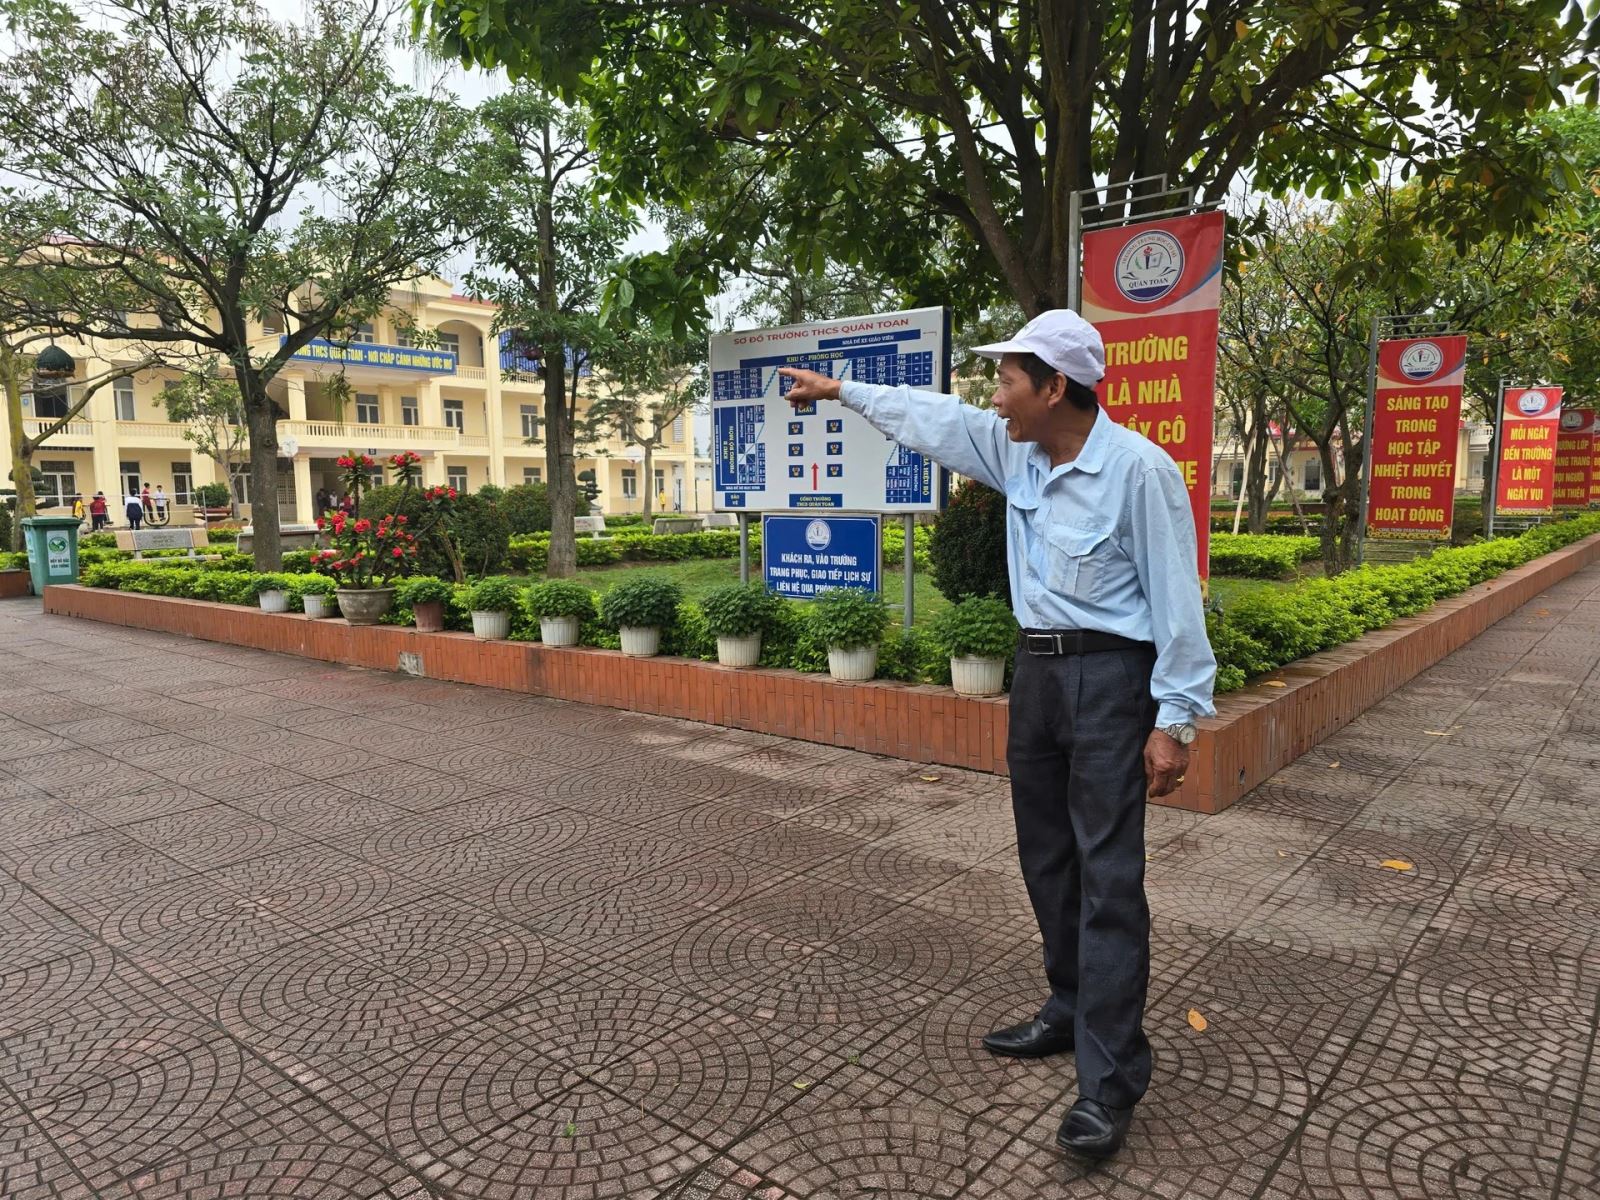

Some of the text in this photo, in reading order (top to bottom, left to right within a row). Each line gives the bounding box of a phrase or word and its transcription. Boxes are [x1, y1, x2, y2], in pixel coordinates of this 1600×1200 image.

[811, 326, 839, 336] THCS
[877, 318, 909, 330] TOAN
[311, 345, 329, 358] THCS
[1105, 333, 1188, 366] TRƯỜNG
[1107, 373, 1182, 406] LÀ NHÀ
[1386, 394, 1449, 412] SÁNG TẠO
[1158, 414, 1186, 445] CÔ
[1395, 418, 1437, 433] TRONG
[1527, 425, 1550, 440] NGÀY
[1388, 438, 1441, 458] HỌC TẬP
[1503, 444, 1553, 461] ĐẾN TRƯỜNG
[1374, 459, 1453, 480] NHIỆT HUYẾT
[1512, 465, 1541, 483] LÀ MỘT
[1390, 486, 1432, 500] TRONG
[1507, 485, 1544, 501] NGÀY VUI
[1375, 505, 1445, 525] HOẠT ĐỘNG
[781, 552, 803, 564] KHÁCH
[815, 553, 829, 565] VÀO
[830, 553, 857, 566] TRƯỜNG
[769, 566, 872, 584] TRANG PHỤC, GIAO TIẾP LỊCH SỰ
[776, 580, 791, 592] LIÊN
[791, 581, 800, 594] HỆ
[801, 583, 814, 593] QUA
